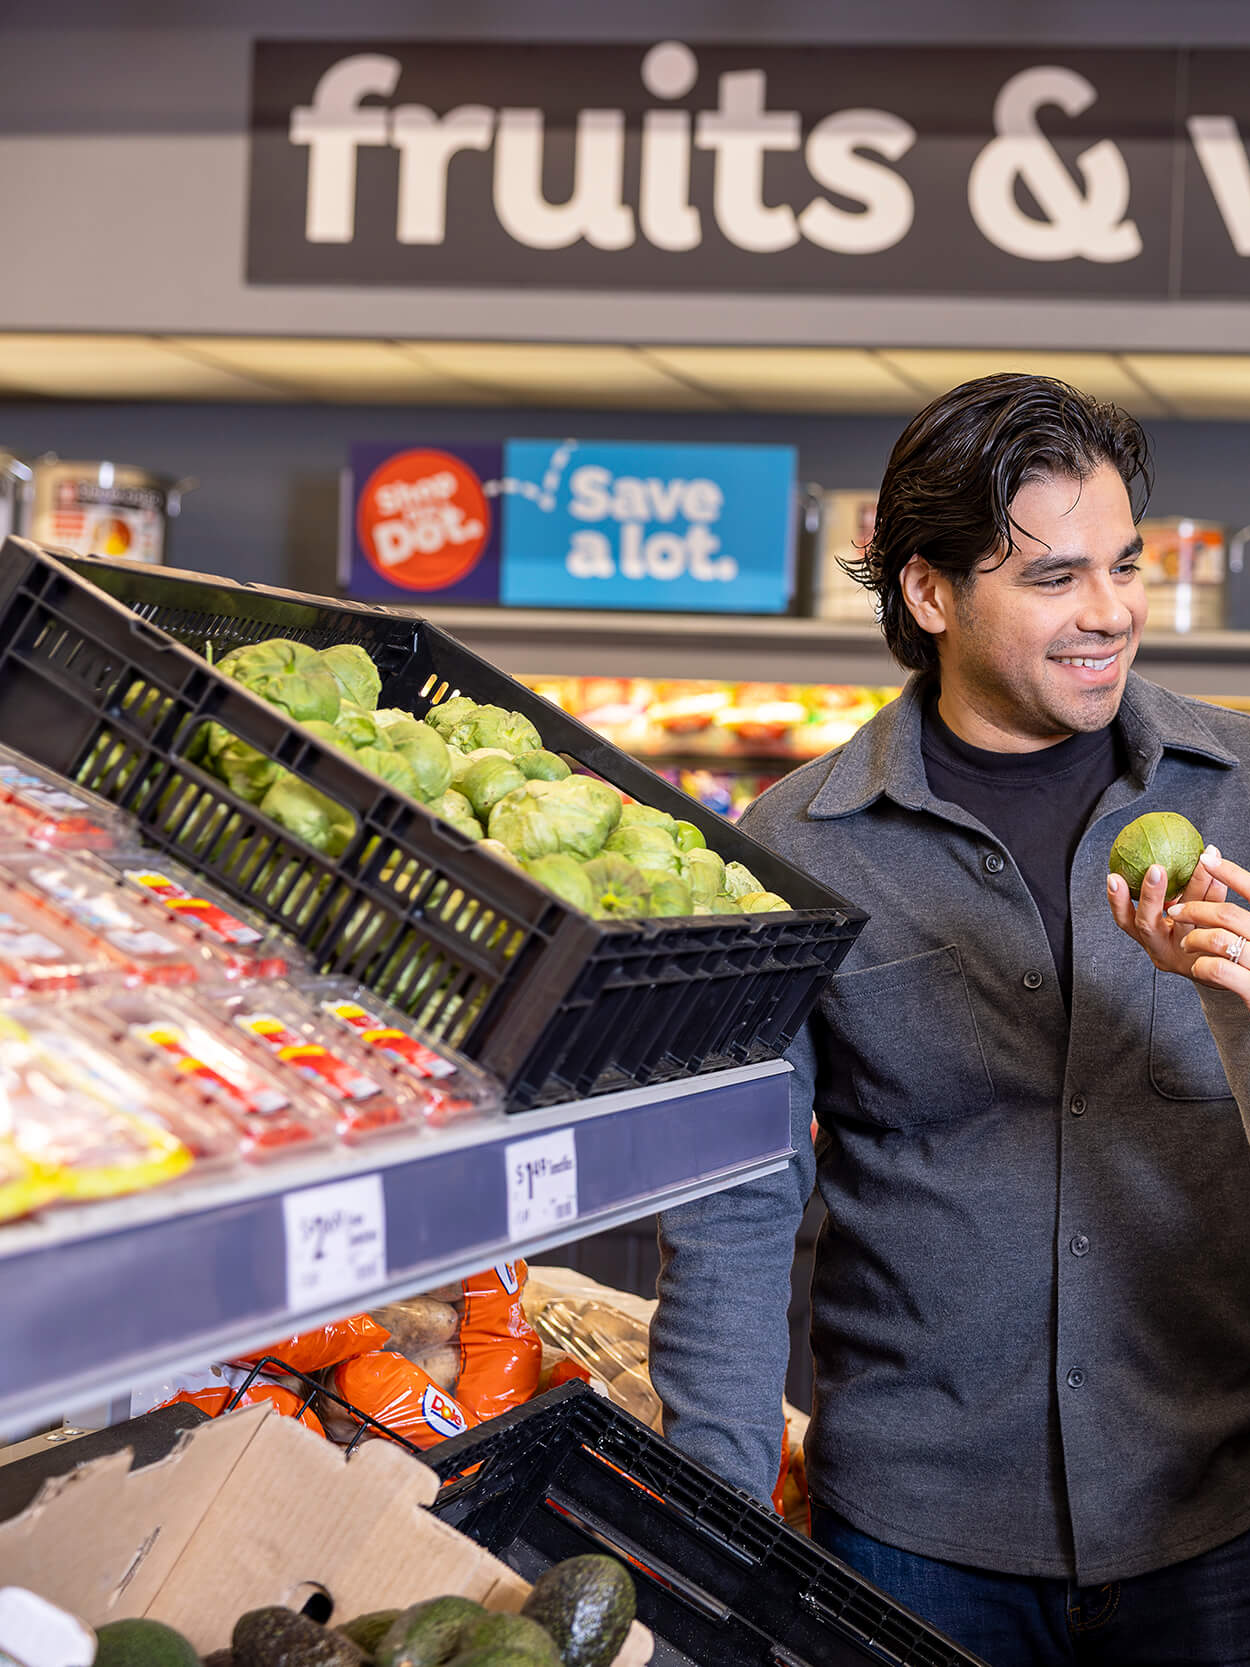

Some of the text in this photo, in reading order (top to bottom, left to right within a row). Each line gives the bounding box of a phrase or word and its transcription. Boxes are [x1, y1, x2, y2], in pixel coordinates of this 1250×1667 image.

[290, 41, 916, 254] fruits
[968, 66, 1143, 263] &
[568, 464, 725, 524] Save
[565, 522, 740, 582] a lot.
[431, 1394, 463, 1426] Dole
